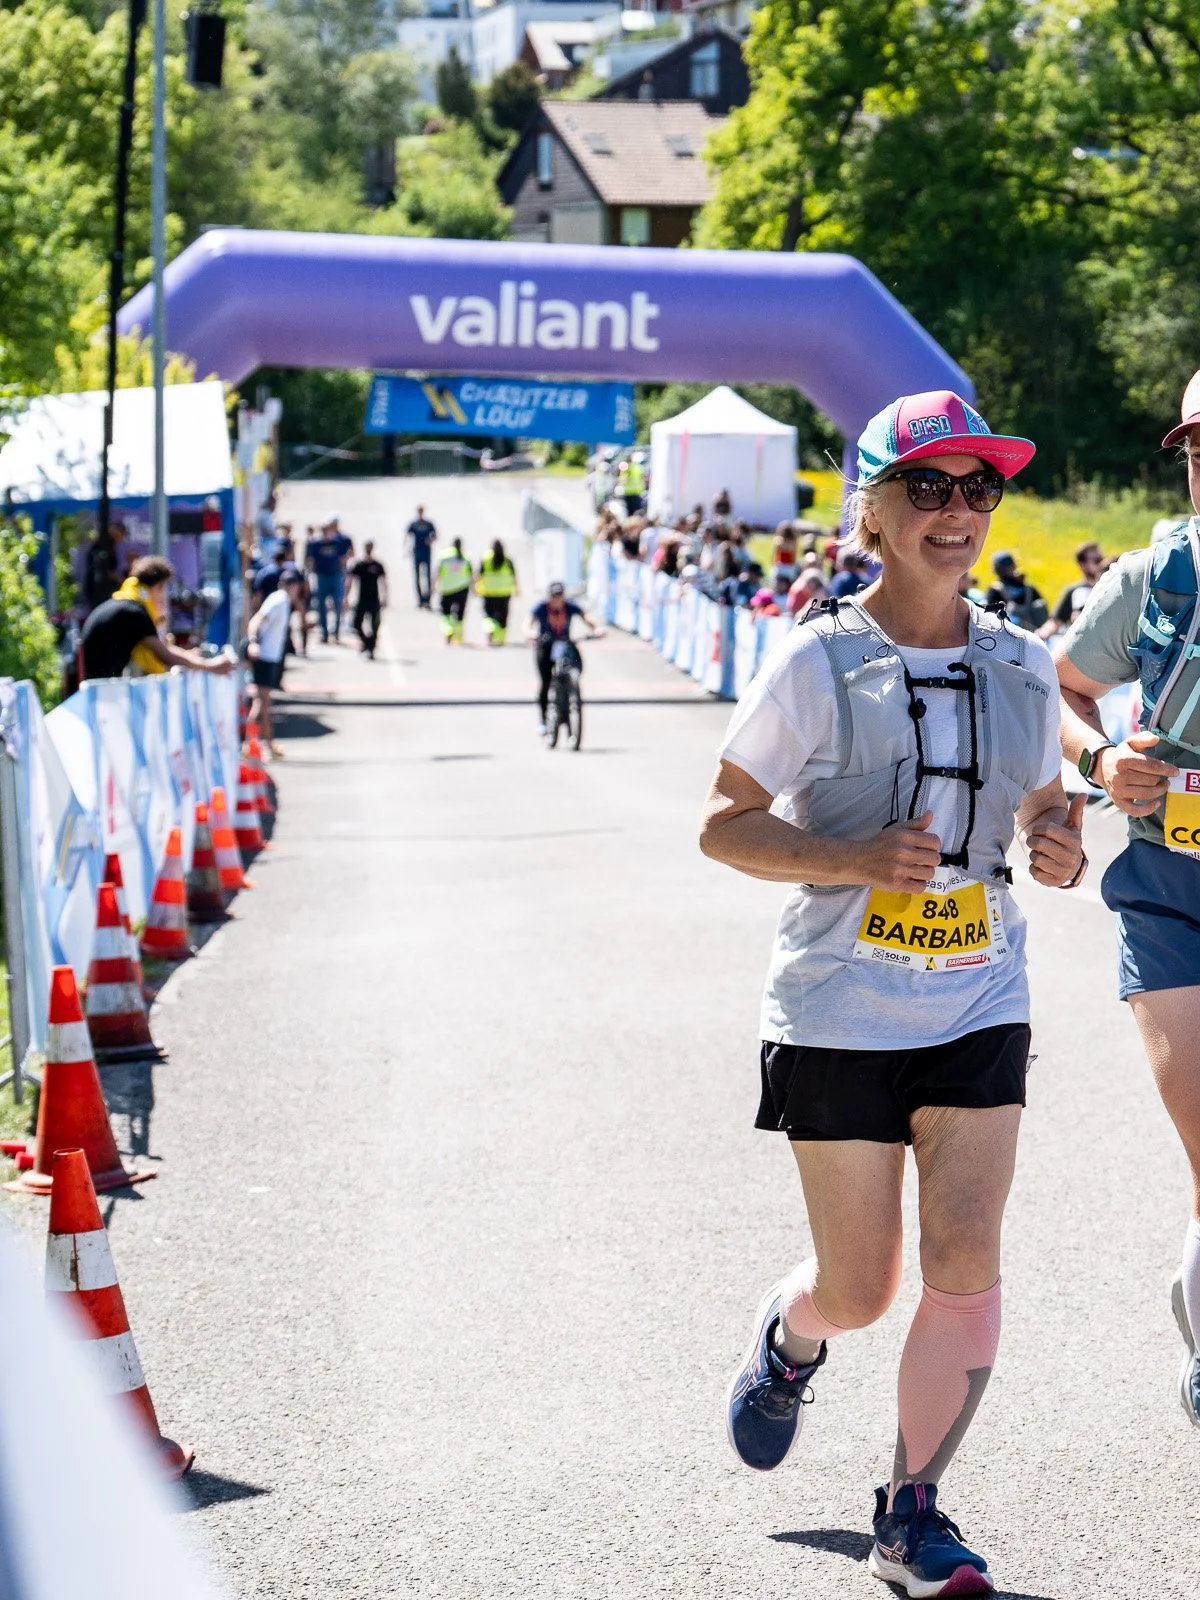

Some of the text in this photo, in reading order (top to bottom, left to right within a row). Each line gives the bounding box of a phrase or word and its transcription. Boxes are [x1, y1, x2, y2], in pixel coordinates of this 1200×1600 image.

[409, 279, 660, 353] valiant
[908, 415, 951, 439] OTSO
[937, 443, 1025, 461] THINK SPORT
[921, 898, 959, 920] 848
[866, 913, 989, 949] BARBARA
[884, 952, 911, 962] SOL-ID
